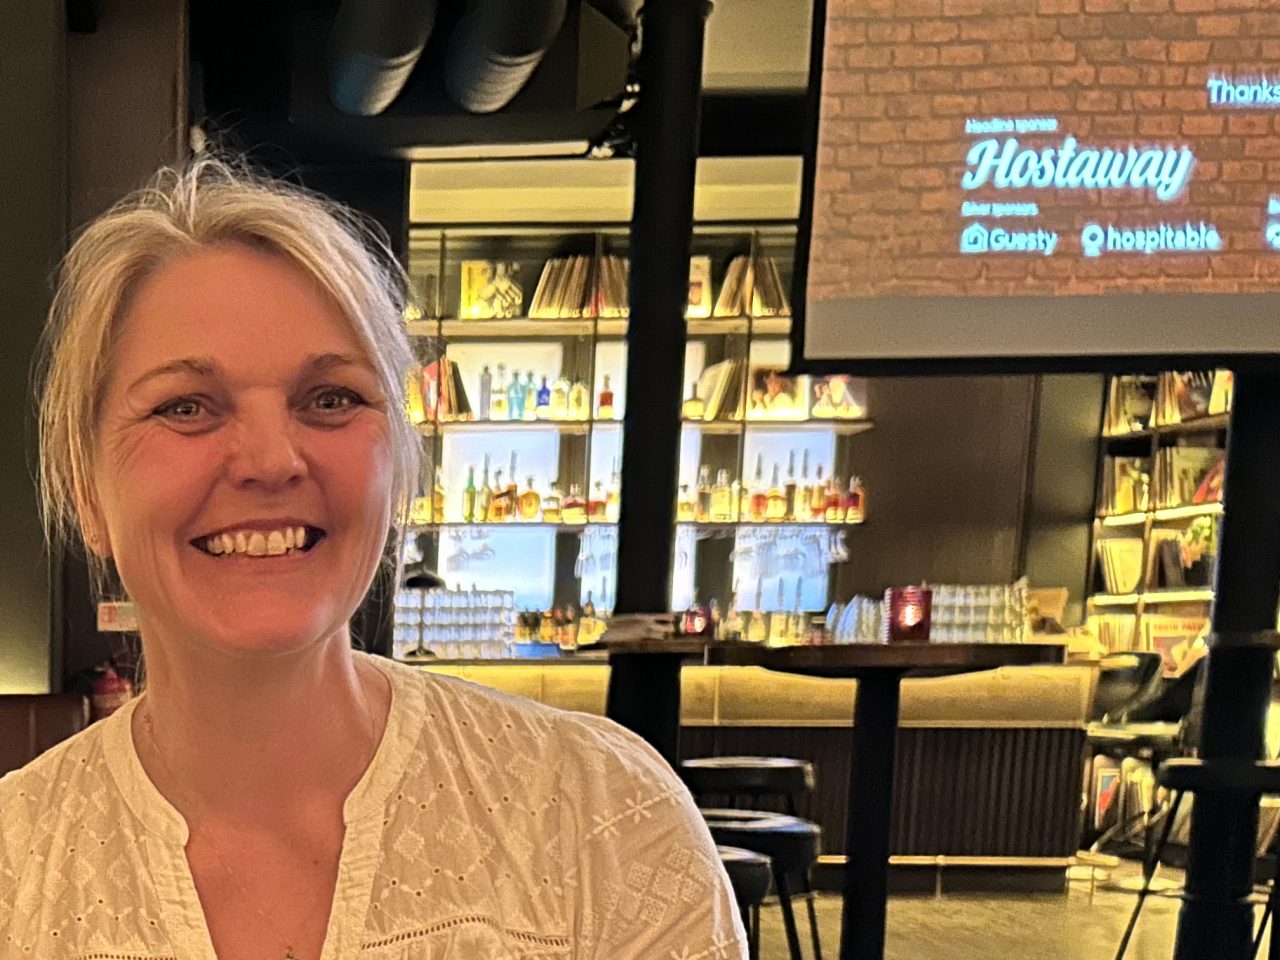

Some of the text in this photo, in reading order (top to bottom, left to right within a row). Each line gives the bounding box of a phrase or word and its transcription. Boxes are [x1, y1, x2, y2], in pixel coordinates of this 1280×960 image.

[1207, 74, 1280, 105] Thanks
[960, 136, 1195, 201] Hostaway
[989, 228, 1058, 256] Guesty
[1106, 222, 1221, 254] hospitable
